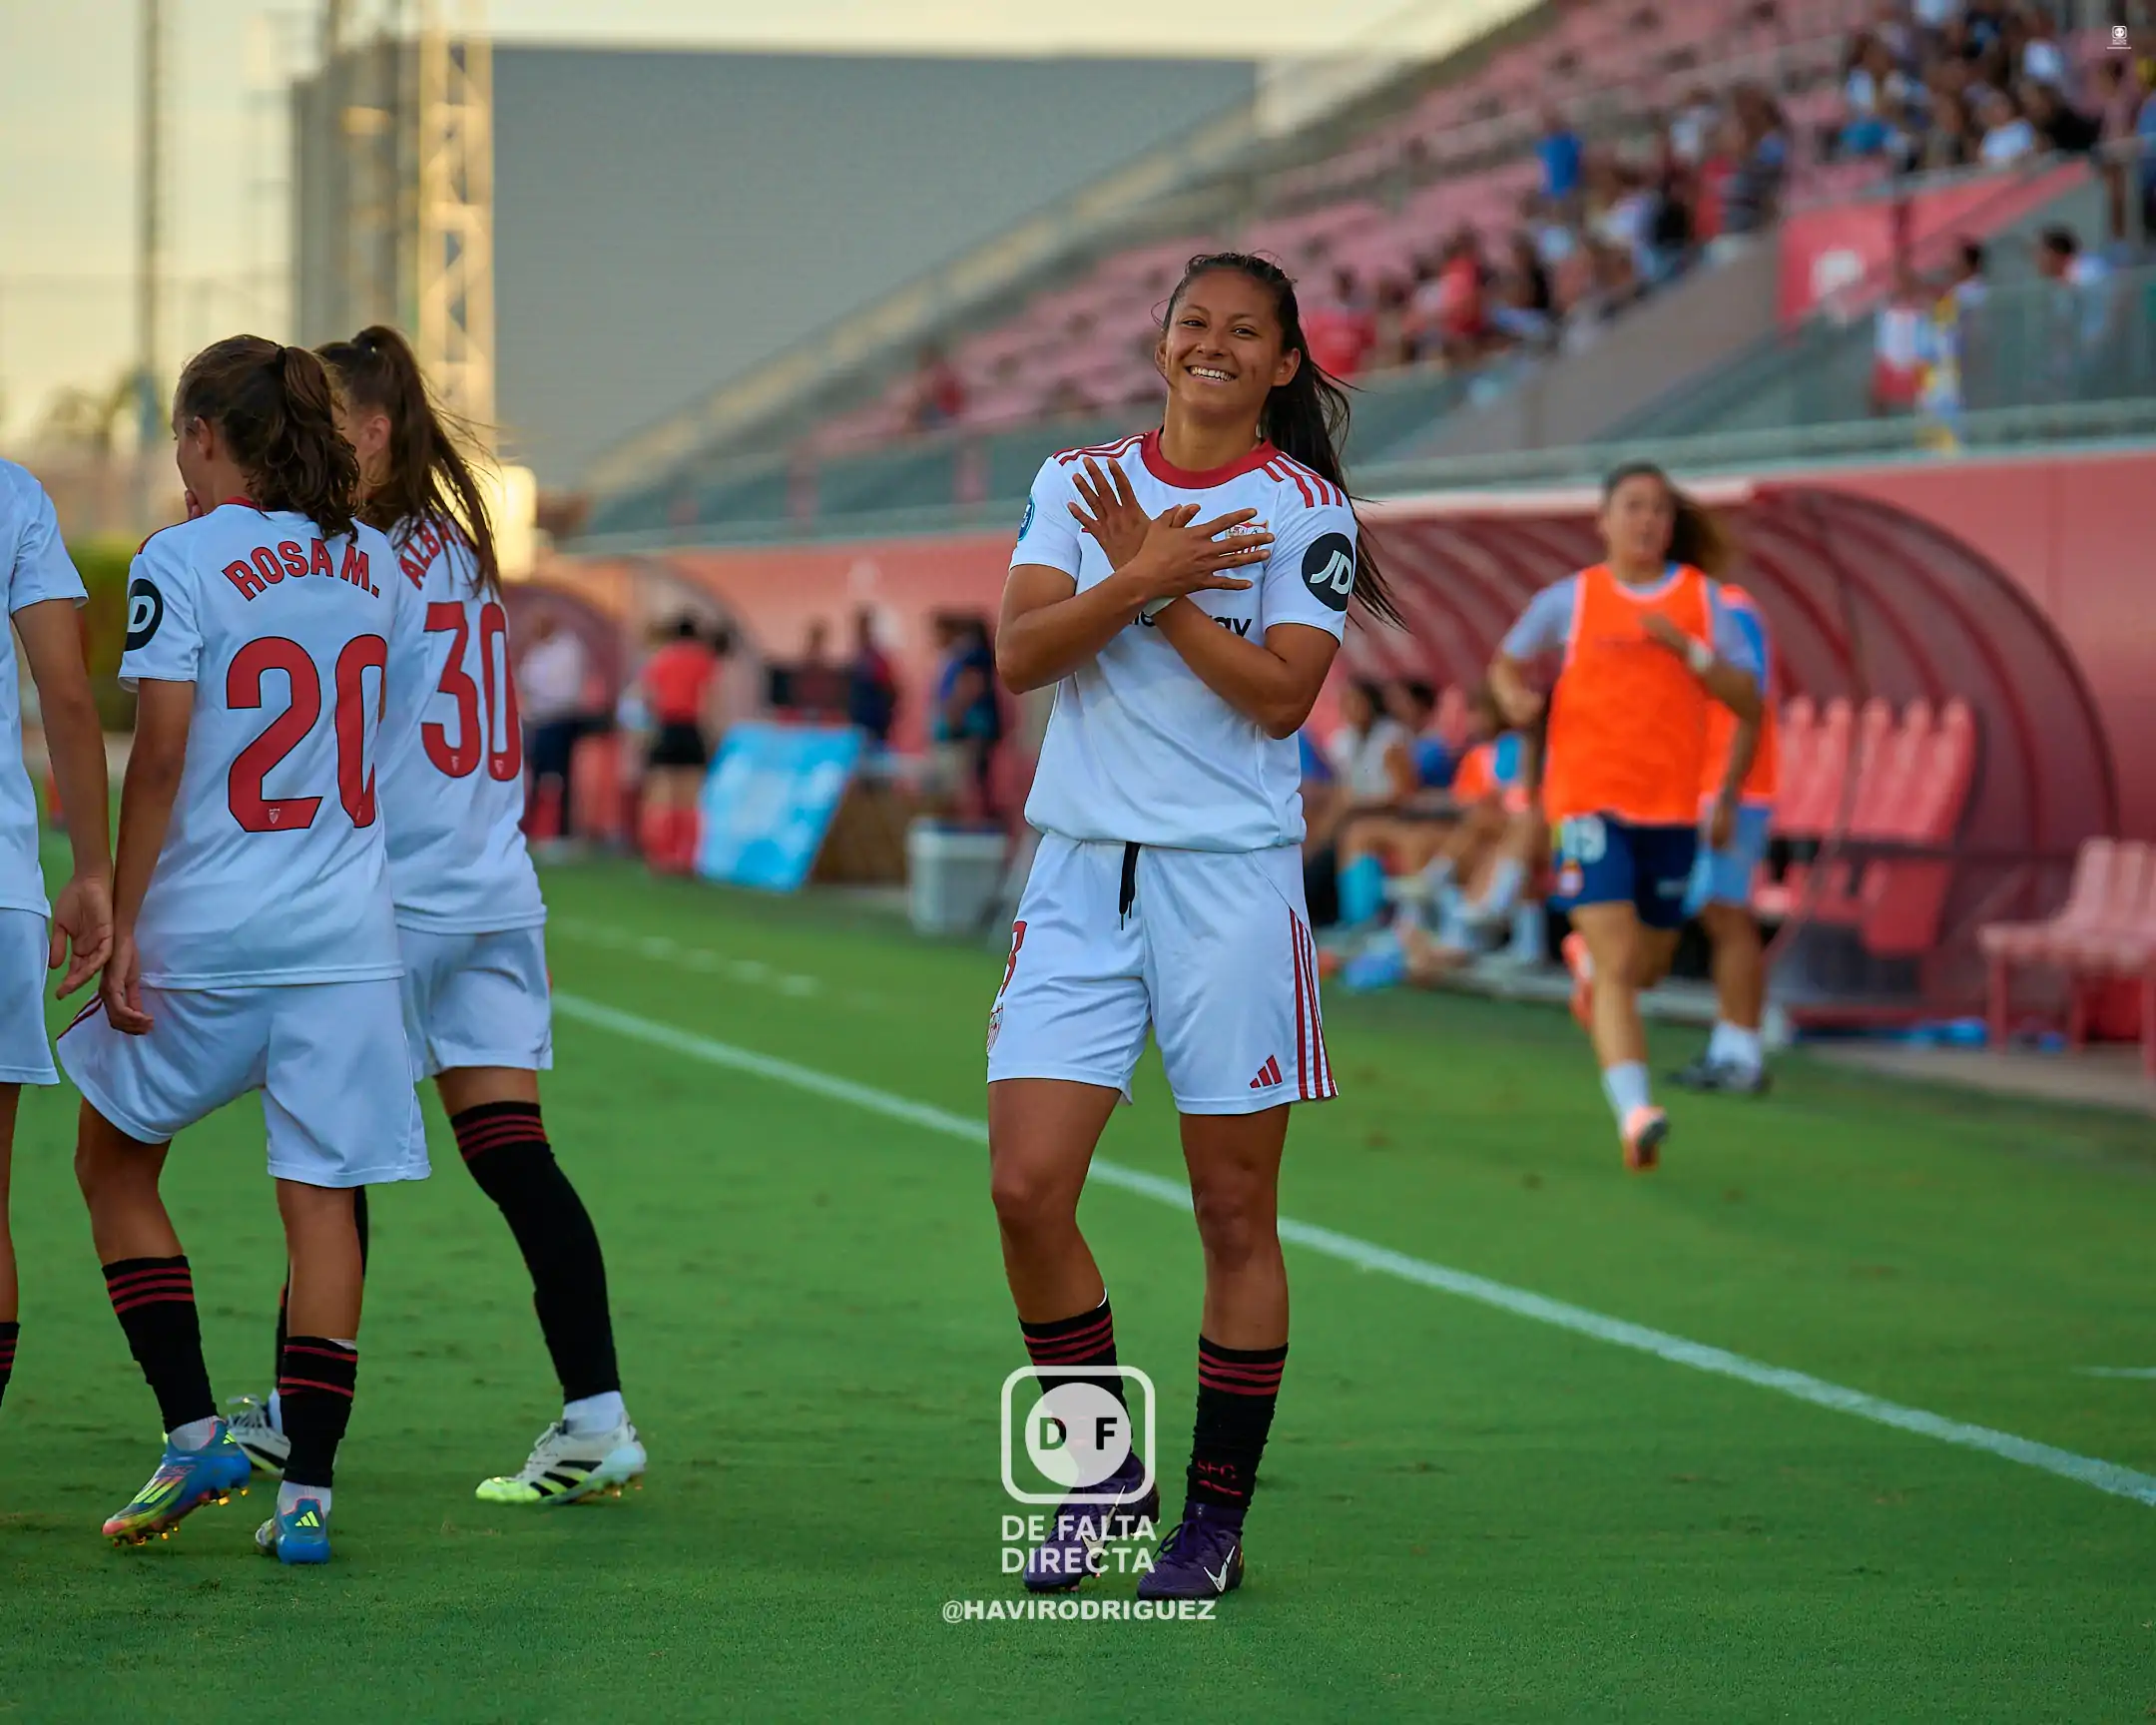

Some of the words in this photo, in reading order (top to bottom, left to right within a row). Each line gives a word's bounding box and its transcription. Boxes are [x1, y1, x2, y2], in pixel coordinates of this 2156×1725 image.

[221, 537, 334, 602] ROSA
[339, 544, 380, 599] M.
[1309, 549, 1352, 595] JD
[127, 595, 156, 633] D
[420, 600, 522, 782] 30
[226, 634, 388, 833] 20
